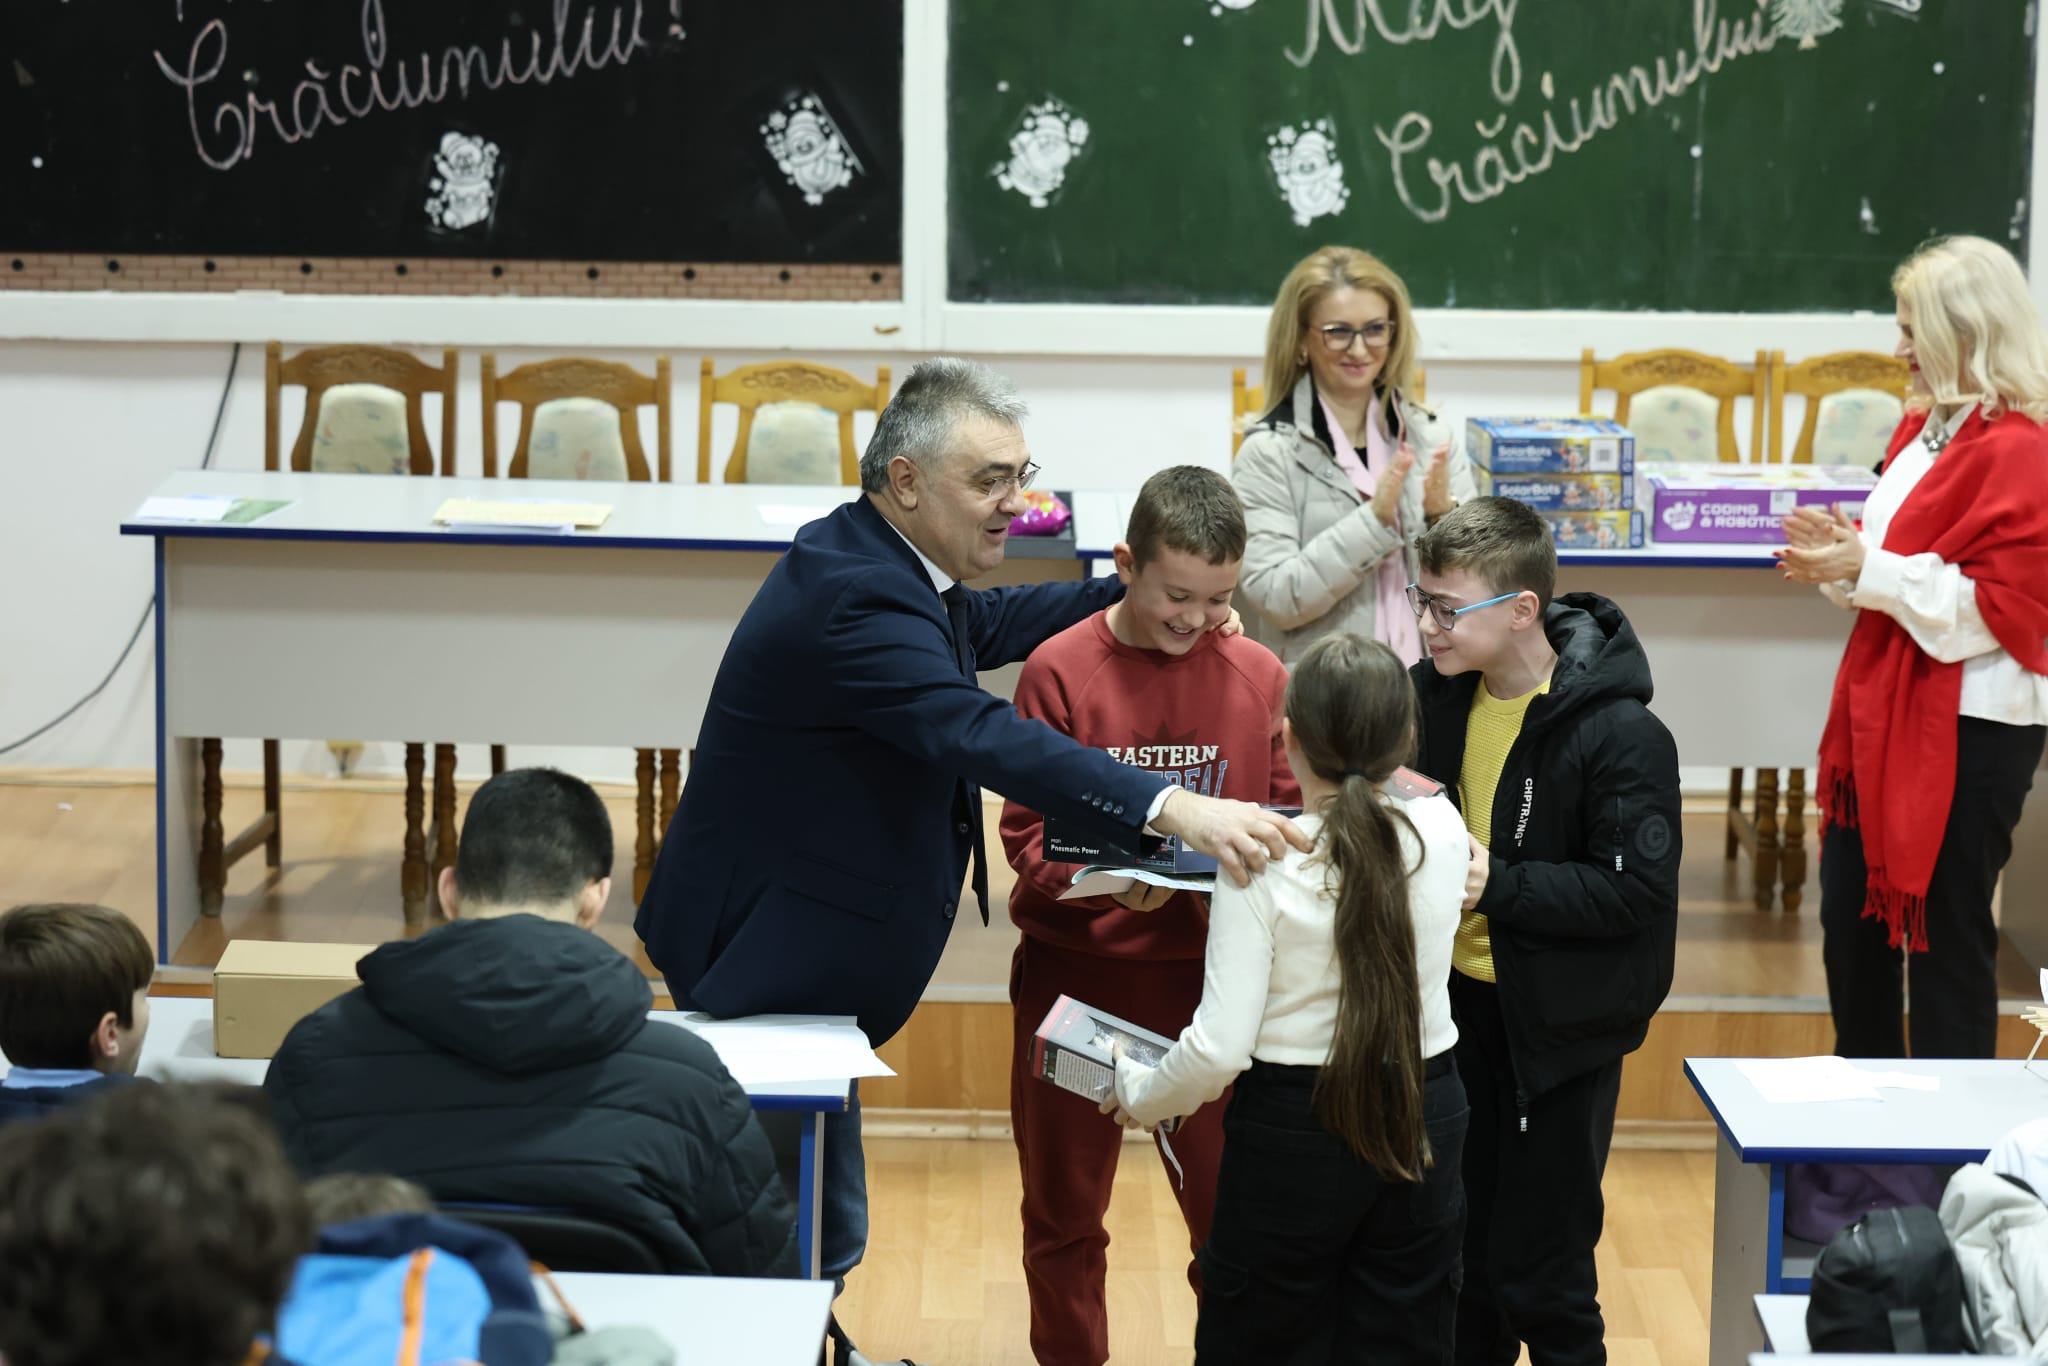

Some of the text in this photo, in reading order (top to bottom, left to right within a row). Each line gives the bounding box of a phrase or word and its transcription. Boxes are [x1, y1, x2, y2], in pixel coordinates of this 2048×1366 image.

[1700, 503, 1759, 516] CODING
[1714, 516, 1782, 528] ROBOTIC
[1106, 745, 1220, 767] EASTERN
[1050, 844, 1100, 855] Pneumatic Power
